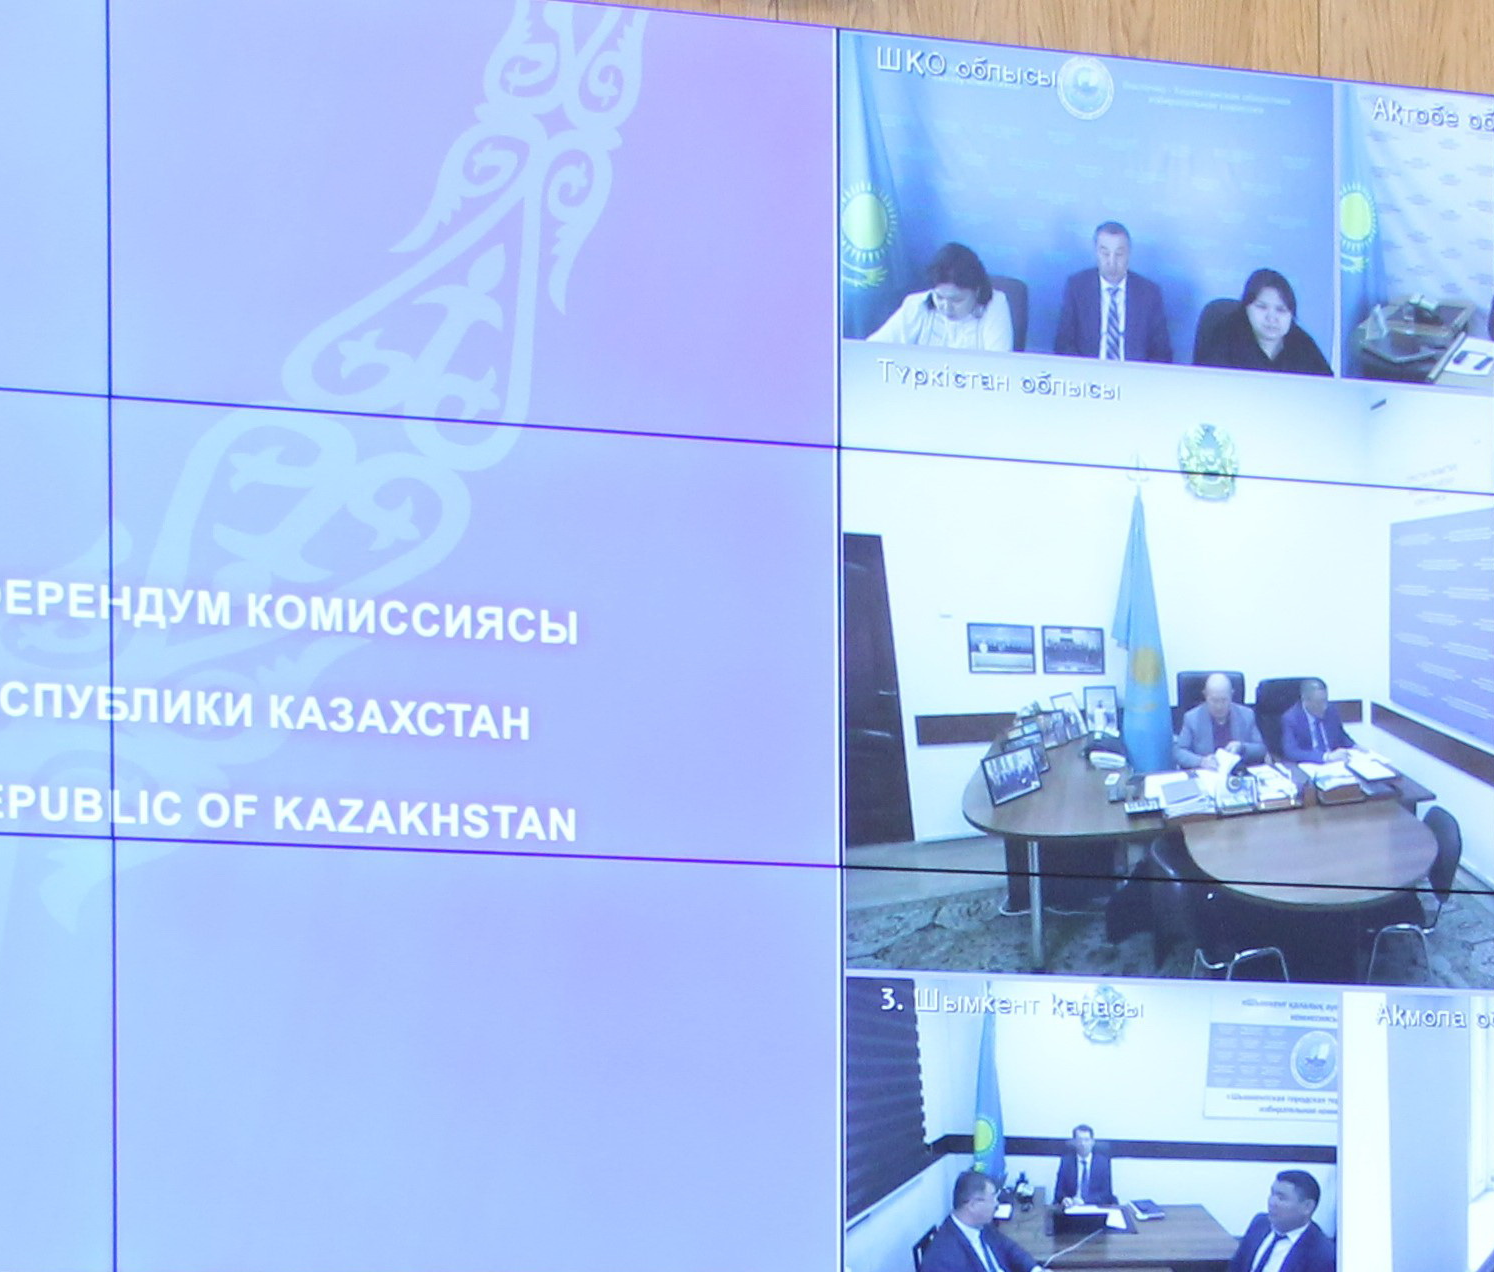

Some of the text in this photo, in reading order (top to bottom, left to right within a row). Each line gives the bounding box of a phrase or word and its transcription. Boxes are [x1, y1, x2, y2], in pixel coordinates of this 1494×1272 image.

[876, 46, 1057, 88] ШҚО облысы
[1021, 371, 1121, 401] облысы
[246, 592, 580, 647] КОМИССИЯСЫ
[269, 693, 530, 742] КАЗАХСТАН
[197, 793, 260, 831] OF
[272, 798, 578, 843] KAZAKHSTAN
[880, 987, 1145, 1019] 3. Шымкент қаласы
